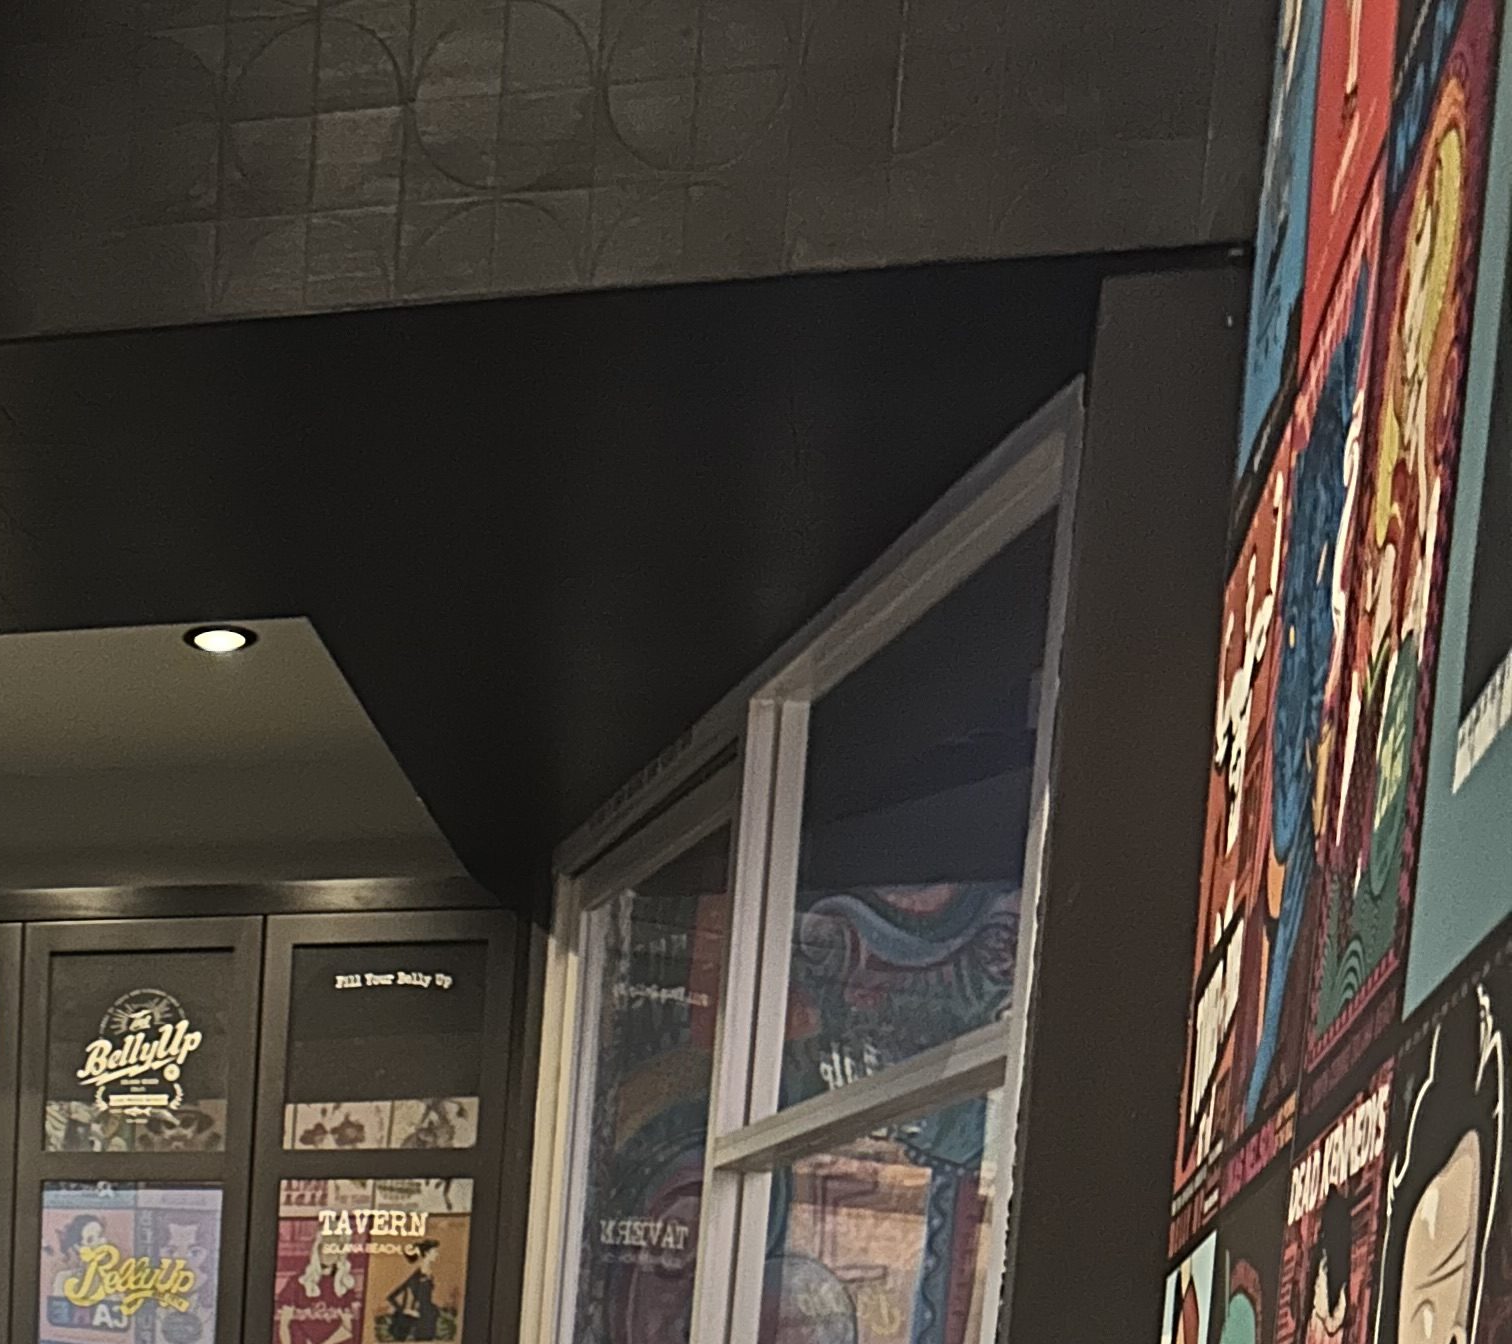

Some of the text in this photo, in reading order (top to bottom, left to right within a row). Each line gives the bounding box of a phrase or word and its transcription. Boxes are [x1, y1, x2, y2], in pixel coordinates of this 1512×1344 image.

[335, 971, 453, 989] Fill Your Belly Up
[1288, 1149, 1321, 1226] DEAD
[1319, 1083, 1389, 1200] KENNEDYS
[318, 1208, 428, 1238] TAVERN
[322, 1243, 364, 1255] SOLANA
